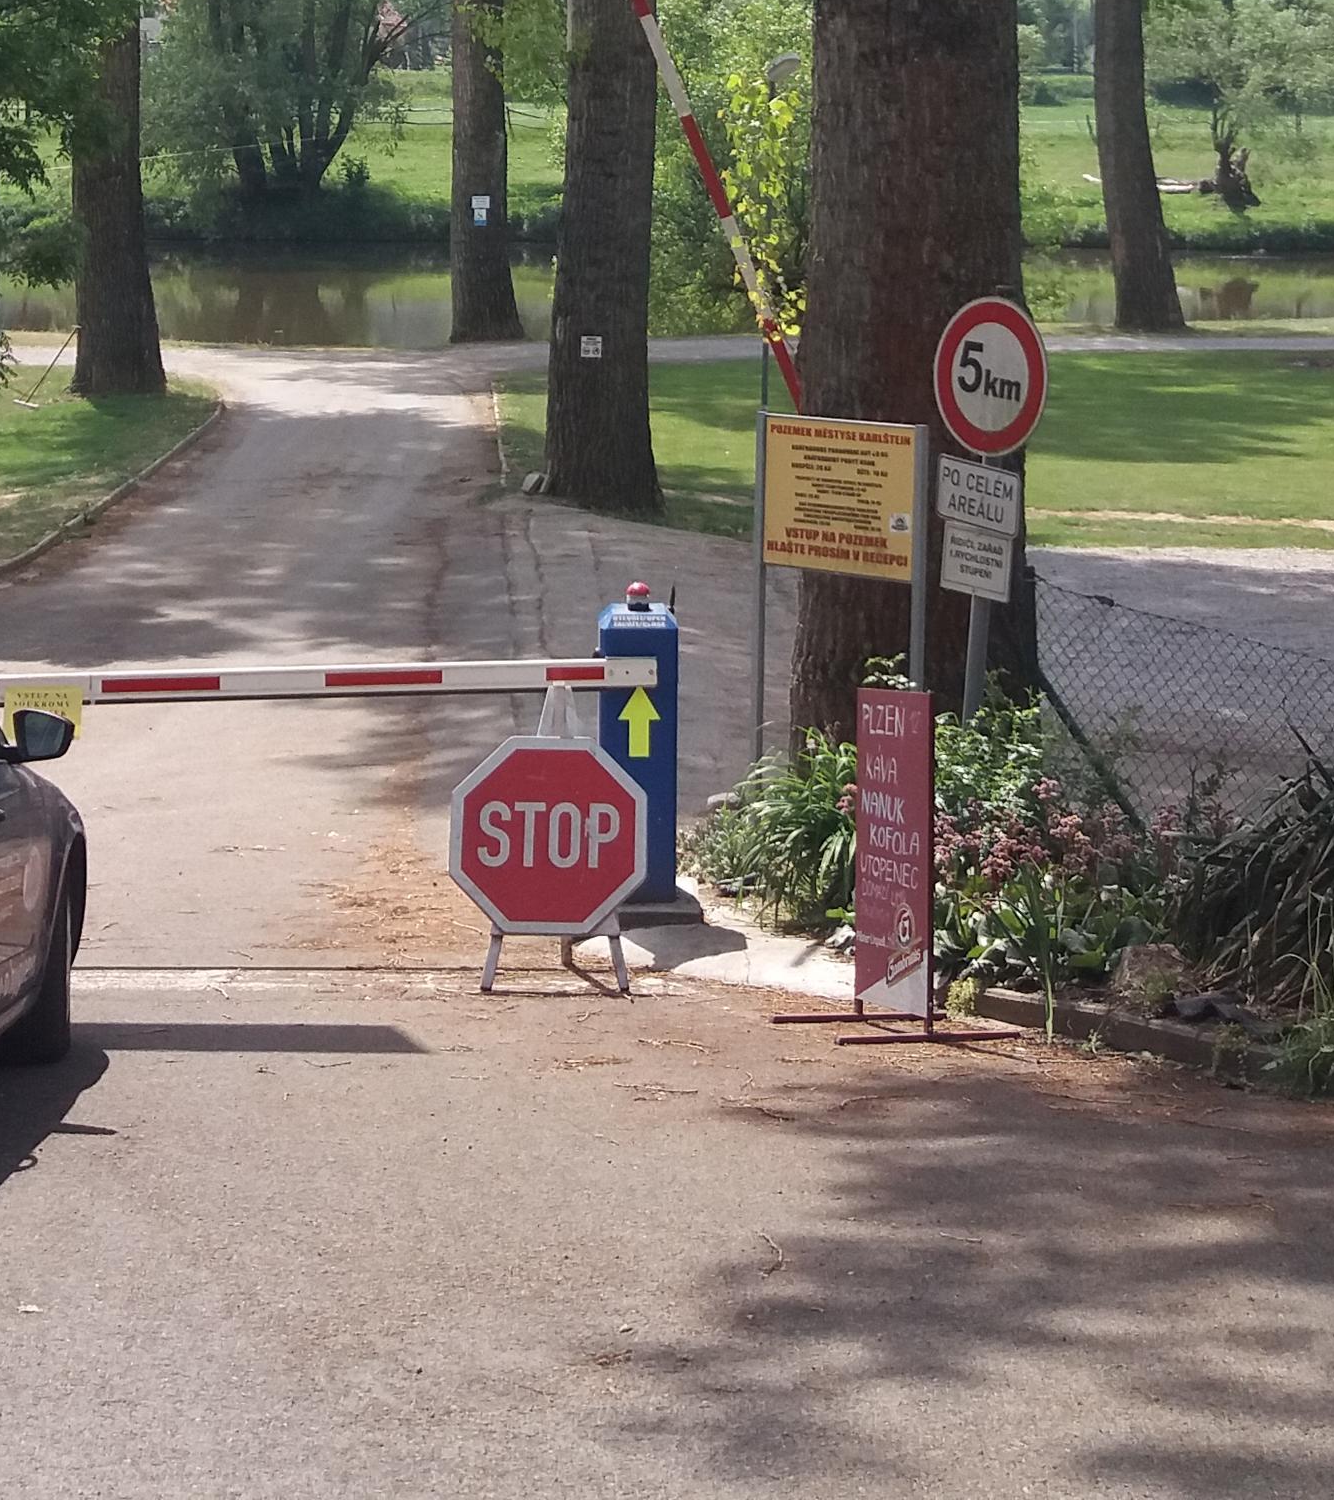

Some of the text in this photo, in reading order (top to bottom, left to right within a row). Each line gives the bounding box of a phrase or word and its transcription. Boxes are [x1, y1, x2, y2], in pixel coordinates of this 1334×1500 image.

[942, 466, 1014, 501] PO CELÉM
[947, 493, 1005, 524] AREÁLU
[785, 527, 820, 541] VSTUP
[821, 530, 836, 544] NA
[866, 744, 898, 784] KÁVA
[861, 788, 905, 825] NANUK
[477, 800, 620, 868] STOP
[869, 823, 920, 856] KOFOLA
[860, 853, 919, 890] UTOPENEC
